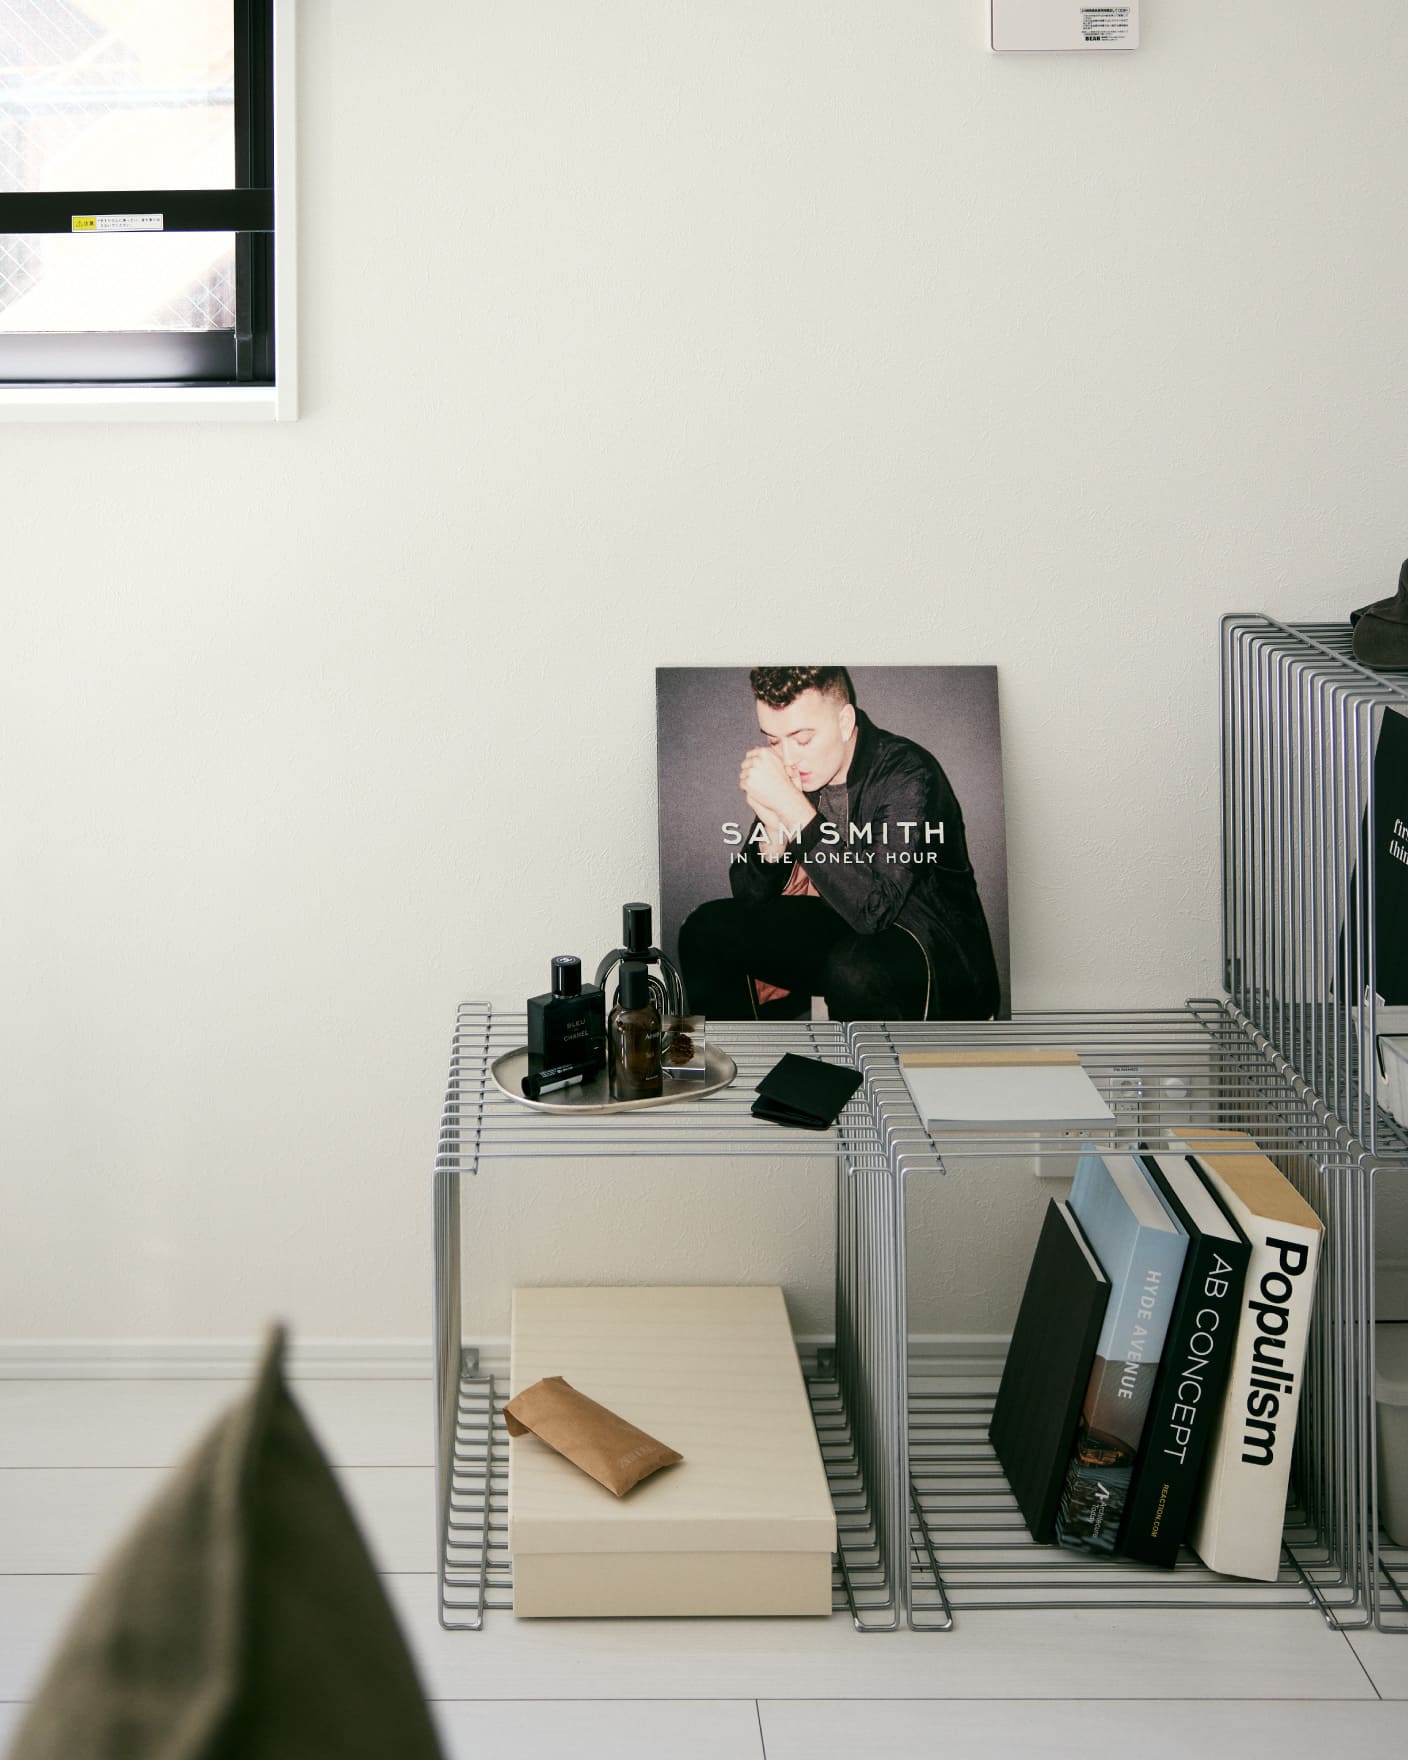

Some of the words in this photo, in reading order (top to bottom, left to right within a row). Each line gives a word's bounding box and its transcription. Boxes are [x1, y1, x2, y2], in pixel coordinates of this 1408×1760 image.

[721, 822, 802, 845] SAM
[819, 821, 945, 845] SMITH
[730, 852, 748, 864] IN
[757, 852, 793, 864] THE
[804, 852, 876, 864] LONELY
[886, 852, 938, 864] HOUR
[1136, 1270, 1162, 1320] HYDE
[1204, 1253, 1233, 1298] AB
[1117, 1326, 1149, 1400] AVENUE
[1240, 1236, 1310, 1467] Populism
[1163, 1308, 1220, 1465] CONCEPT
